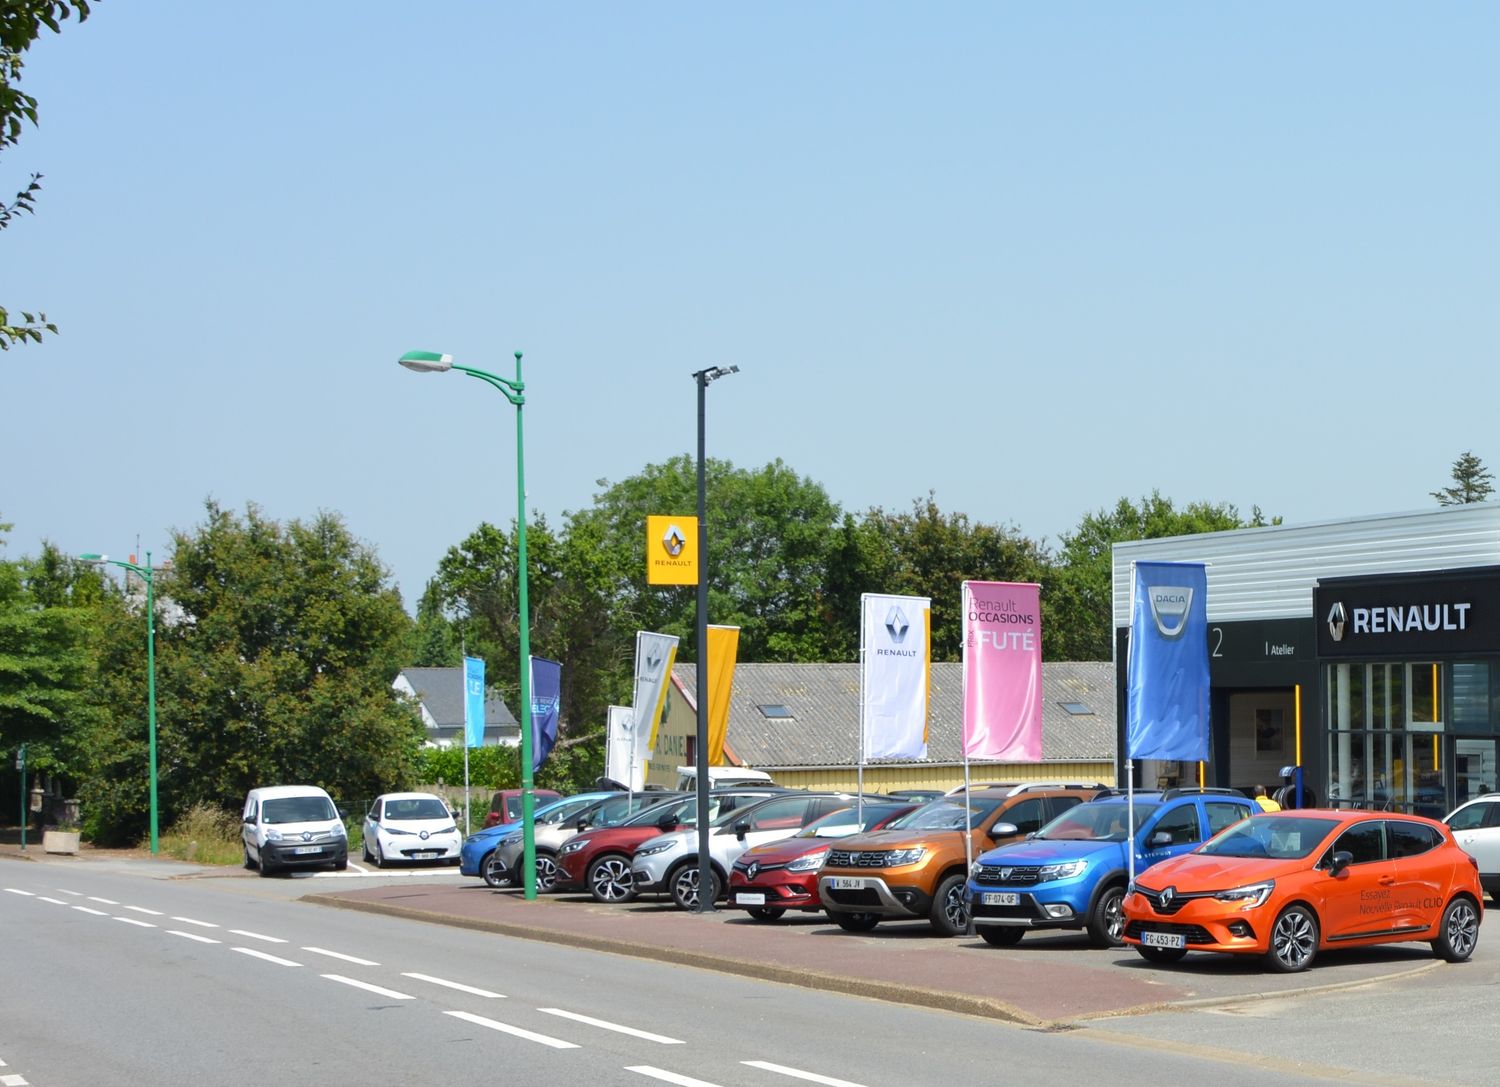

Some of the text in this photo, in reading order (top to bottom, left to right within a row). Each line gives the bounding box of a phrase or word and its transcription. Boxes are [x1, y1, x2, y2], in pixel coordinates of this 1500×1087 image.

[969, 597, 1017, 612] Renault
[1155, 594, 1186, 604] DACIA
[968, 612, 1034, 625] OCCASIONS
[1353, 603, 1471, 633] RENAULT
[977, 628, 1035, 651] FUTÉ
[1212, 627, 1223, 658] 2
[877, 649, 917, 657] RENAULT
[1271, 645, 1295, 656] Atelier
[1360, 896, 1444, 915] Nouvelle Renault CLIO
